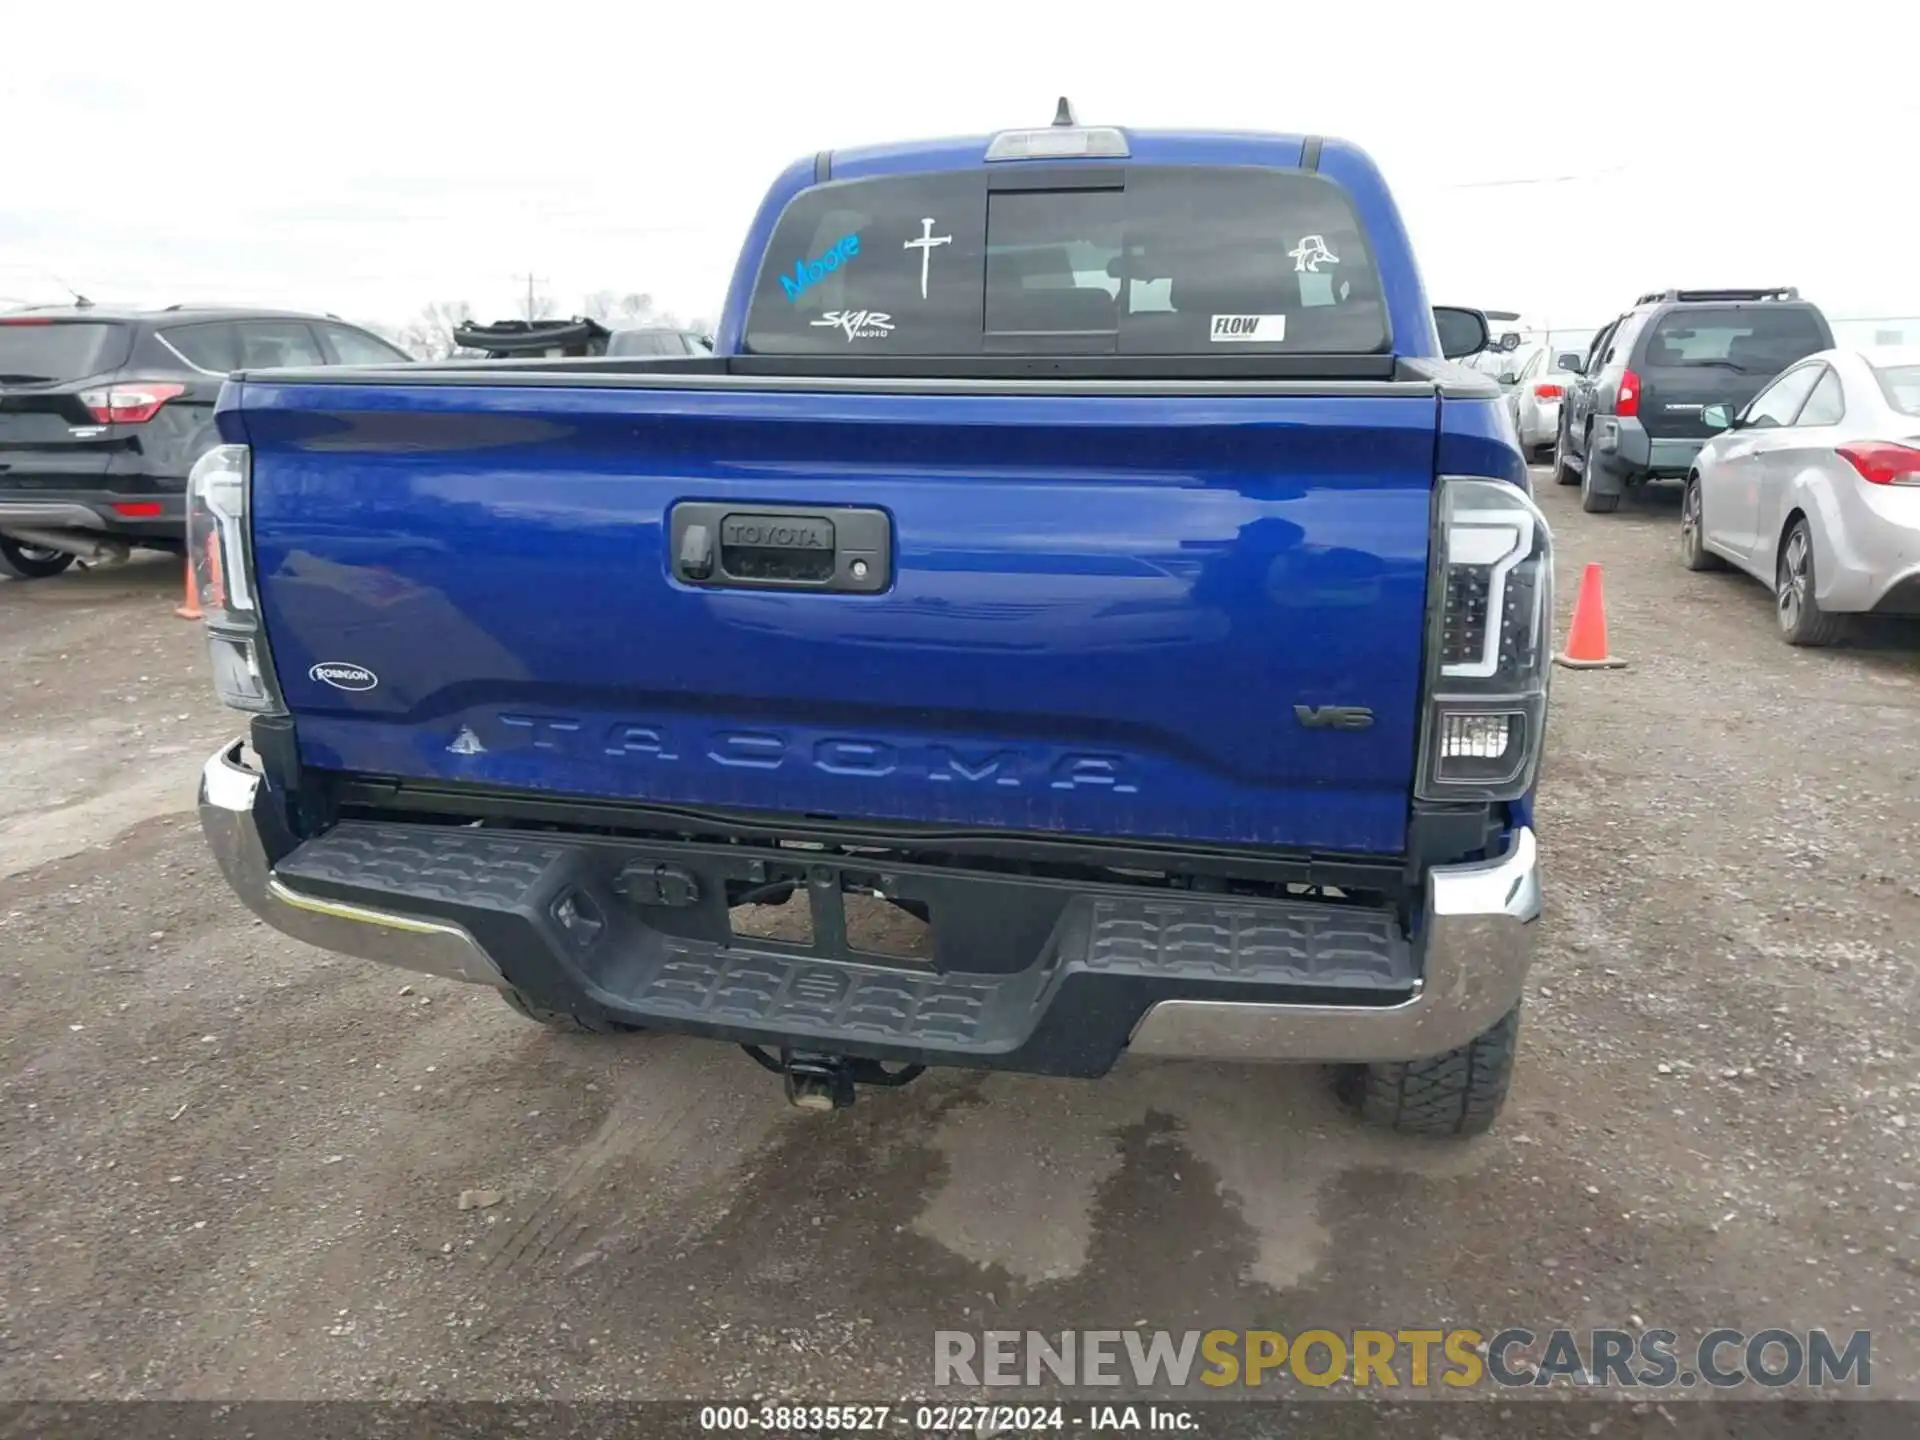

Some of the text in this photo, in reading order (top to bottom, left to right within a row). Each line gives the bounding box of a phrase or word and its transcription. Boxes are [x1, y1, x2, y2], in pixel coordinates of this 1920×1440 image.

[778, 233, 861, 303] Moore
[809, 309, 896, 342] SKAR
[1213, 316, 1260, 334] FLOW
[729, 523, 823, 548] TOYOTA
[315, 667, 370, 681] ROBINSON
[1292, 704, 1374, 728] V6
[498, 712, 1140, 794] TACOMA
